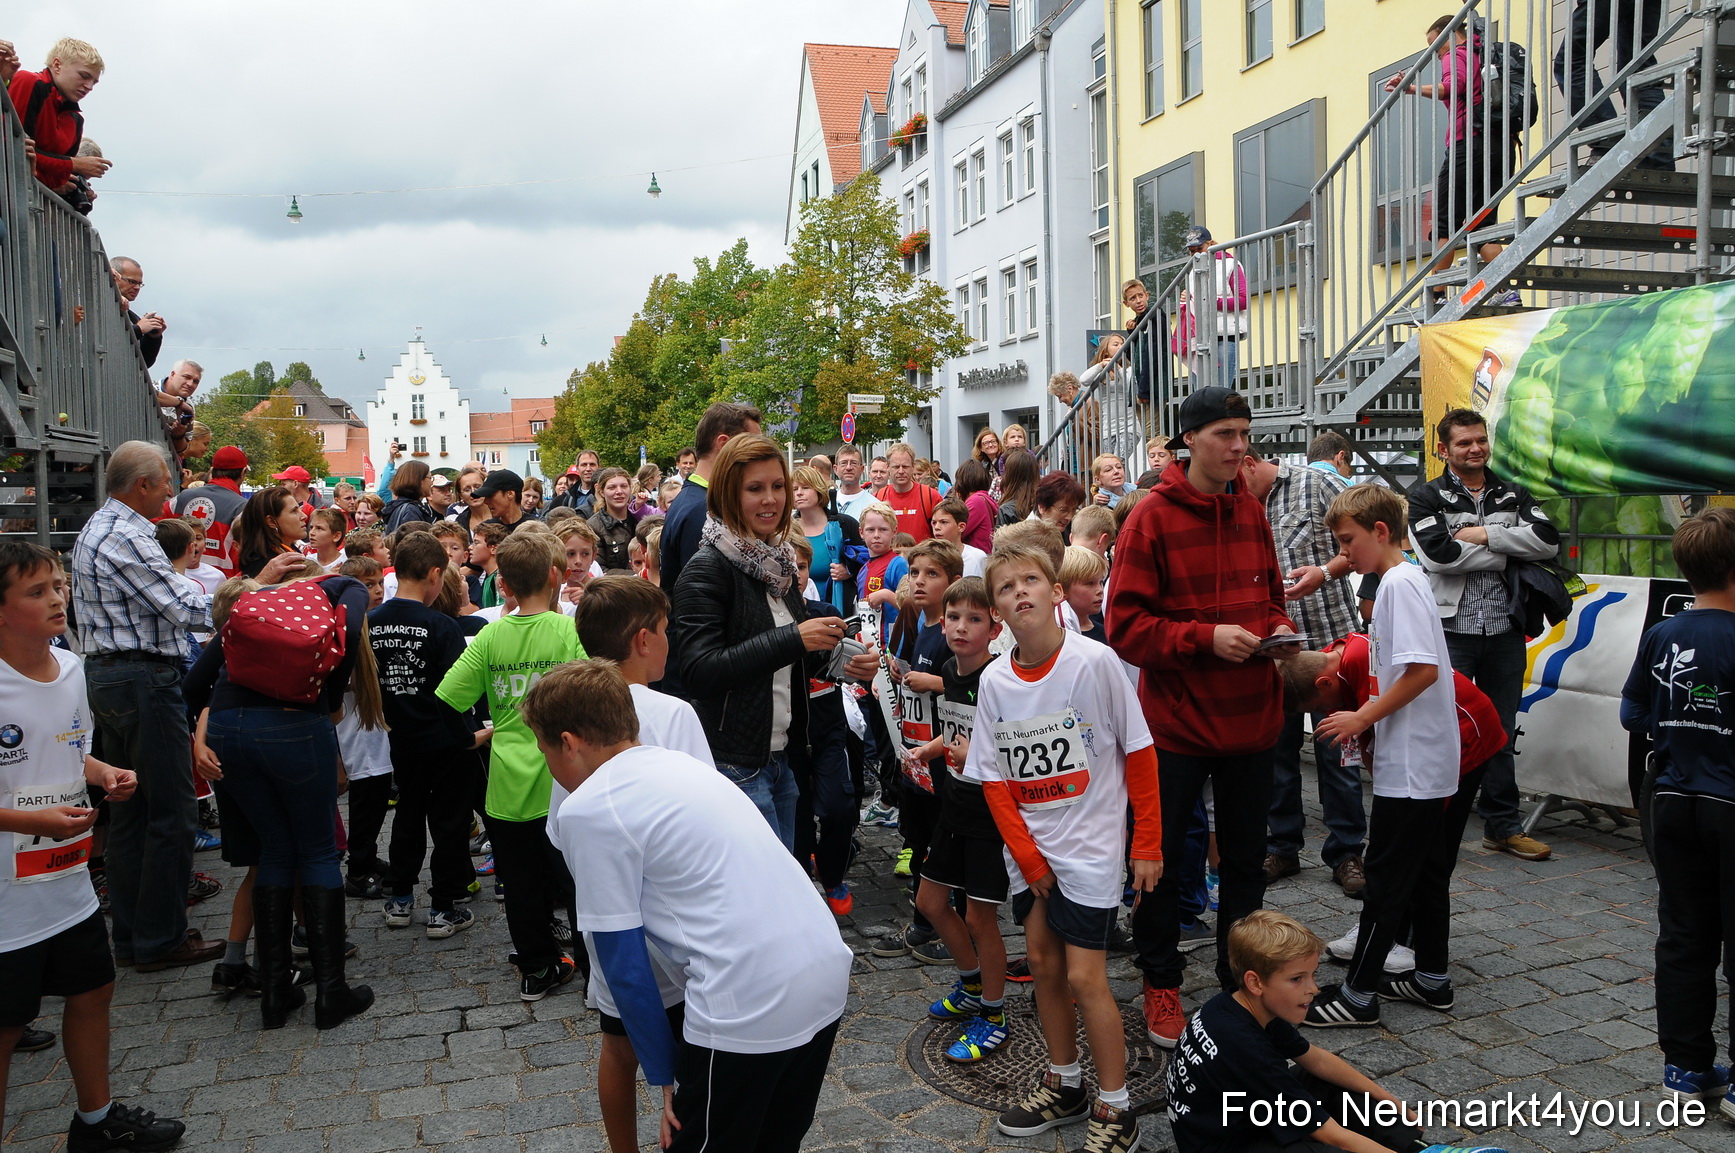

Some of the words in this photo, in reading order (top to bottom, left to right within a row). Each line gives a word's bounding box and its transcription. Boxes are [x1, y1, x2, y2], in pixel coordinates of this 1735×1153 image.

[369, 625, 428, 637] NEUMARKTER
[372, 639, 423, 650] STADTLAUF
[405, 650, 426, 669] 2013
[489, 664, 506, 672] EAM
[509, 672, 546, 697] DA
[1013, 723, 1059, 740] Neumarkt
[999, 737, 1075, 779] 7232
[1020, 781, 1066, 800] Patrick
[17, 795, 57, 807] PARTL
[46, 850, 80, 869] Jonas
[1176, 1057, 1197, 1094] 2013
